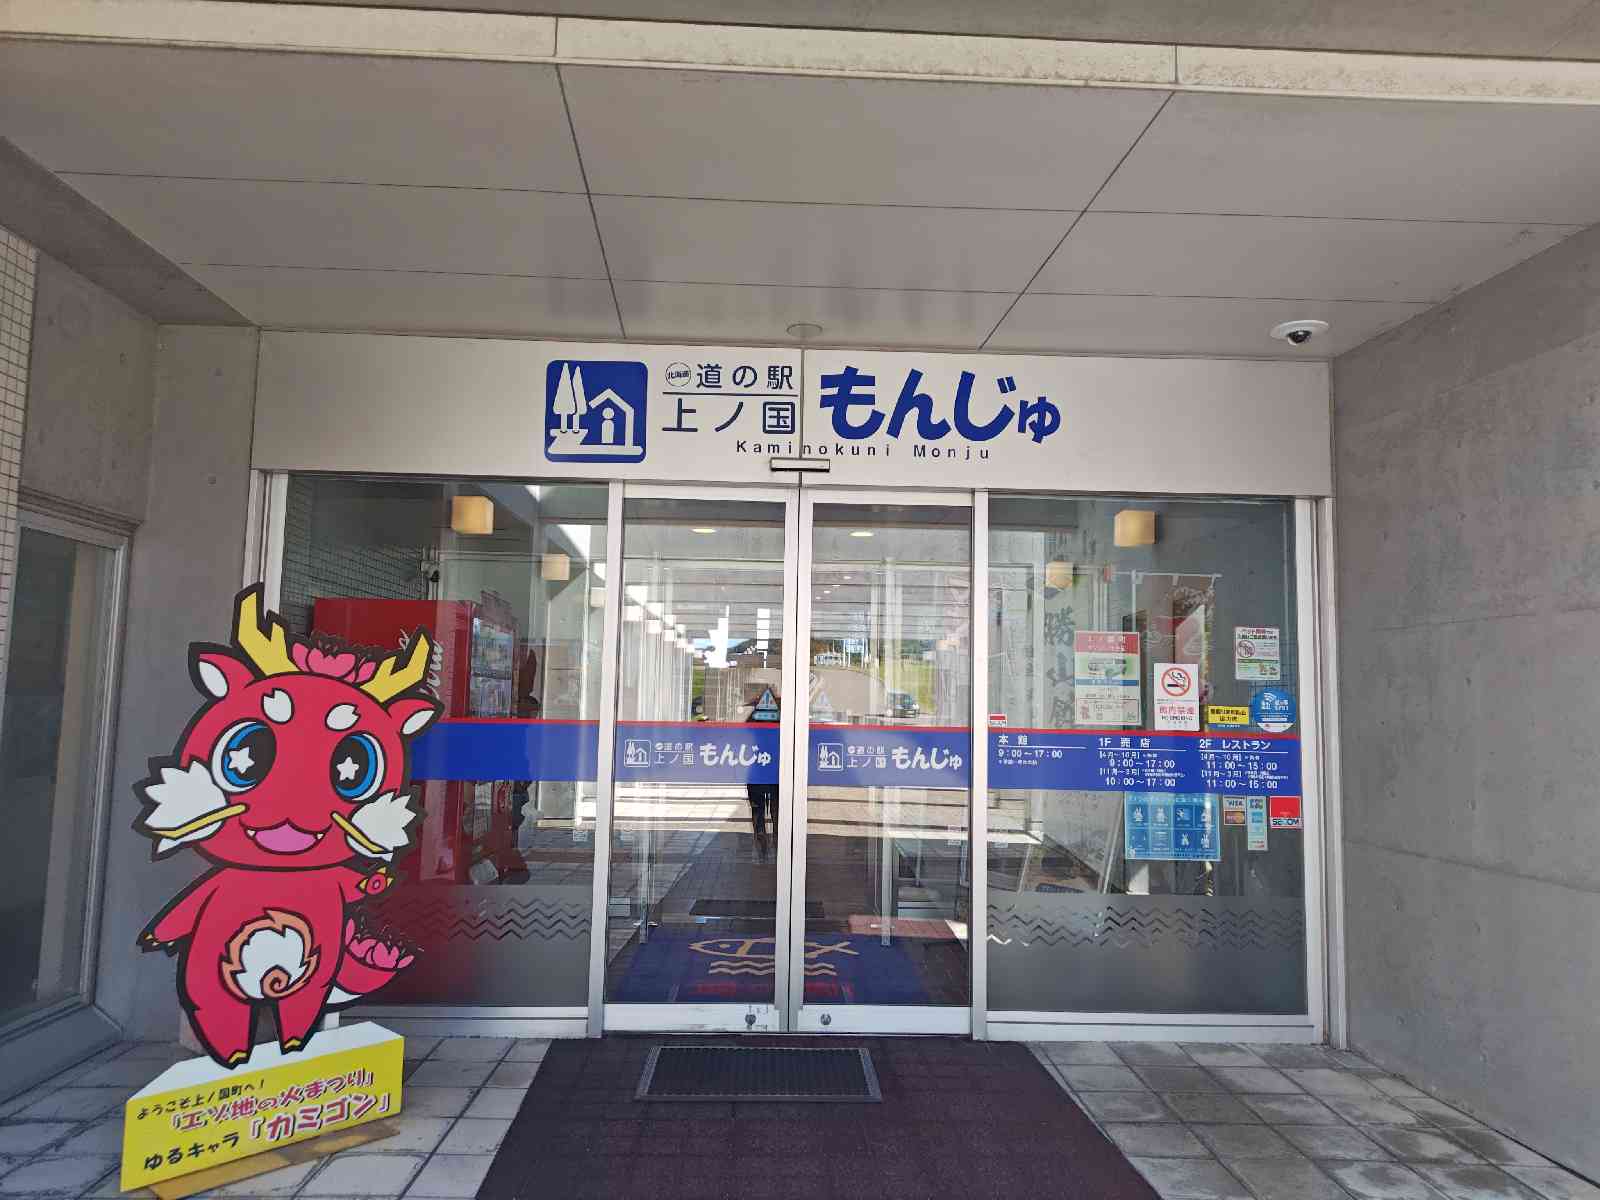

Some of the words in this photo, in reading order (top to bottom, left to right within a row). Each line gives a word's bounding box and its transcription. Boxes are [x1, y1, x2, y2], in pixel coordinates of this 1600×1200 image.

[696, 363, 793, 389] 道の駅
[662, 397, 795, 434] 上ノ国
[819, 365, 1062, 443] もんじゅ
[736, 440, 891, 457] Kaminokuni
[912, 444, 991, 461] Monju
[699, 742, 771, 767] もんじゅ
[1098, 737, 1112, 747] 1F
[1120, 737, 1151, 748] 売店
[1199, 738, 1212, 749] 2F
[1222, 739, 1271, 750] レストラン
[891, 746, 963, 770] もんじゅ
[143, 1131, 240, 1171] ゆるキャラ
